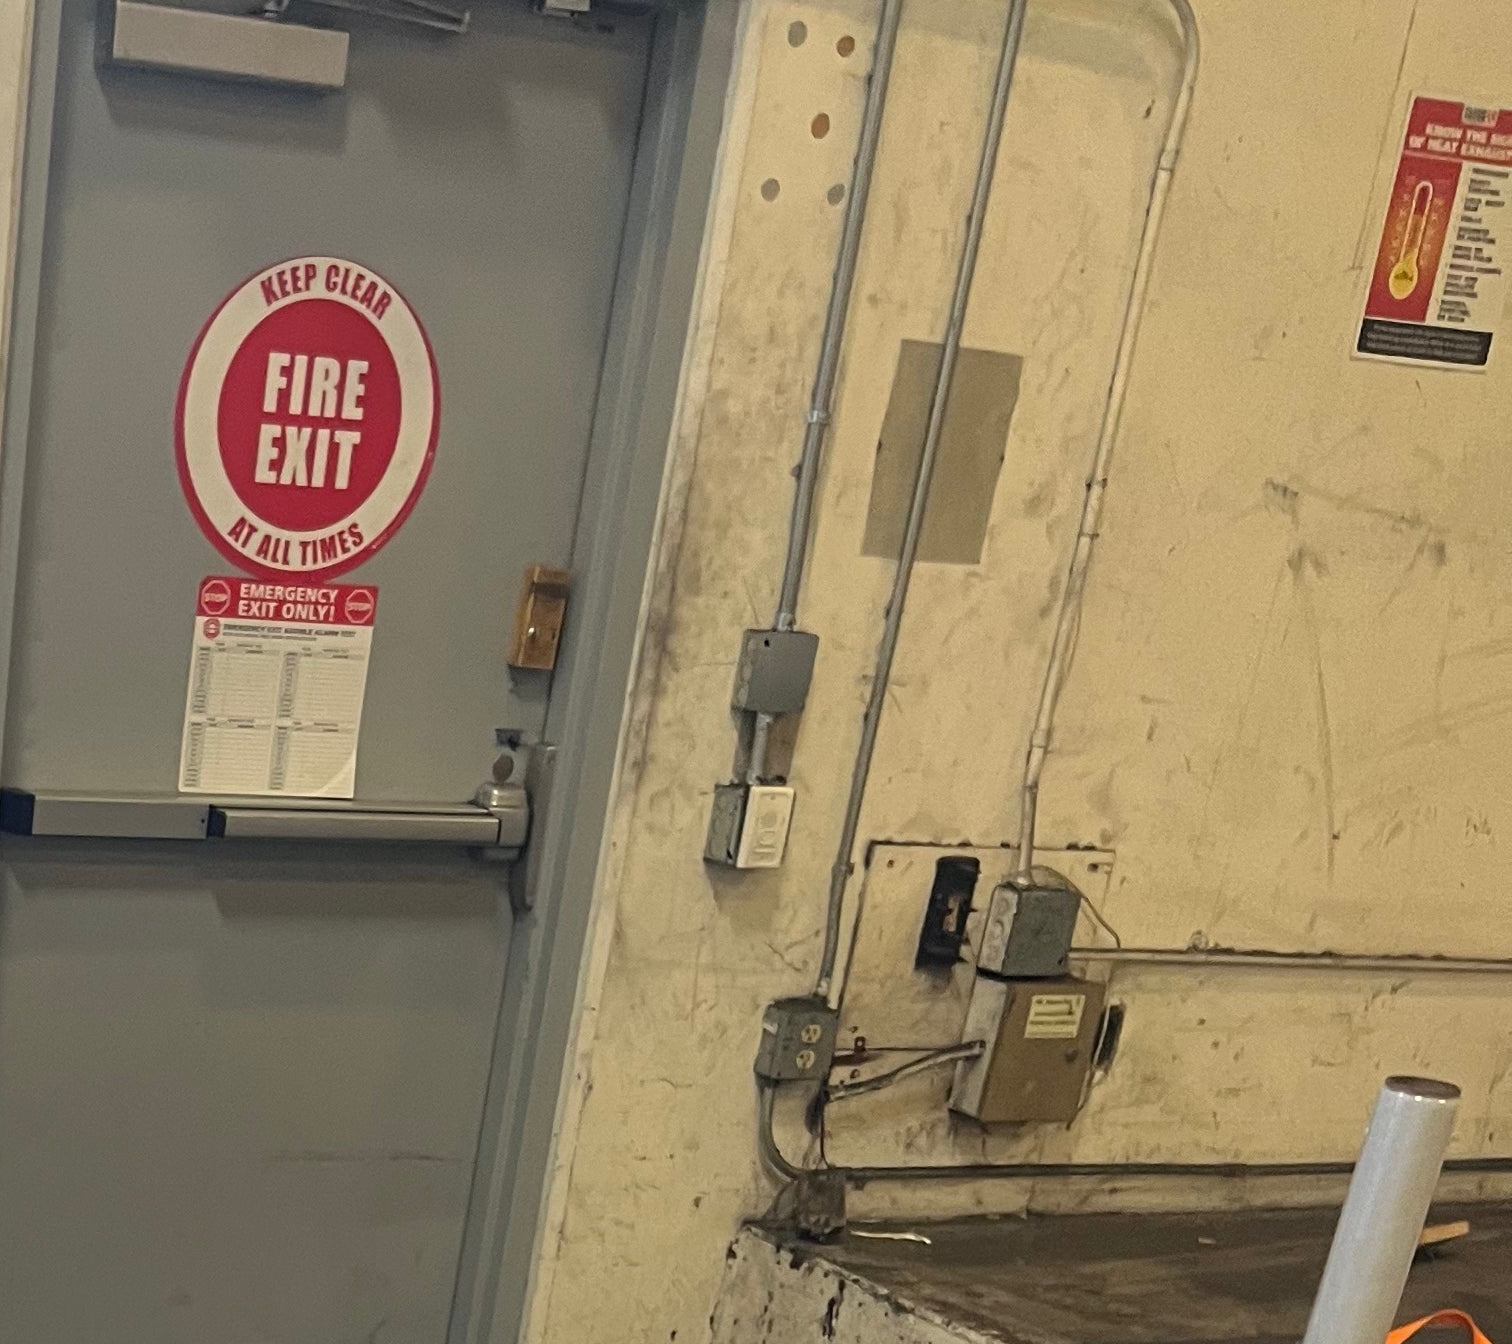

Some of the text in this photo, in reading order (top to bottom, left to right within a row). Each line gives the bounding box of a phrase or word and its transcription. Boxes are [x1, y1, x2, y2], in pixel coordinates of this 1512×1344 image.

[260, 263, 392, 320] KEEP CLEAR
[263, 352, 369, 420] FIRE
[255, 423, 361, 489] EXIT
[227, 516, 364, 566] AT ALL TIMES
[238, 601, 336, 621] EXIT ONLY!
[240, 583, 338, 603] EMERGENCY
